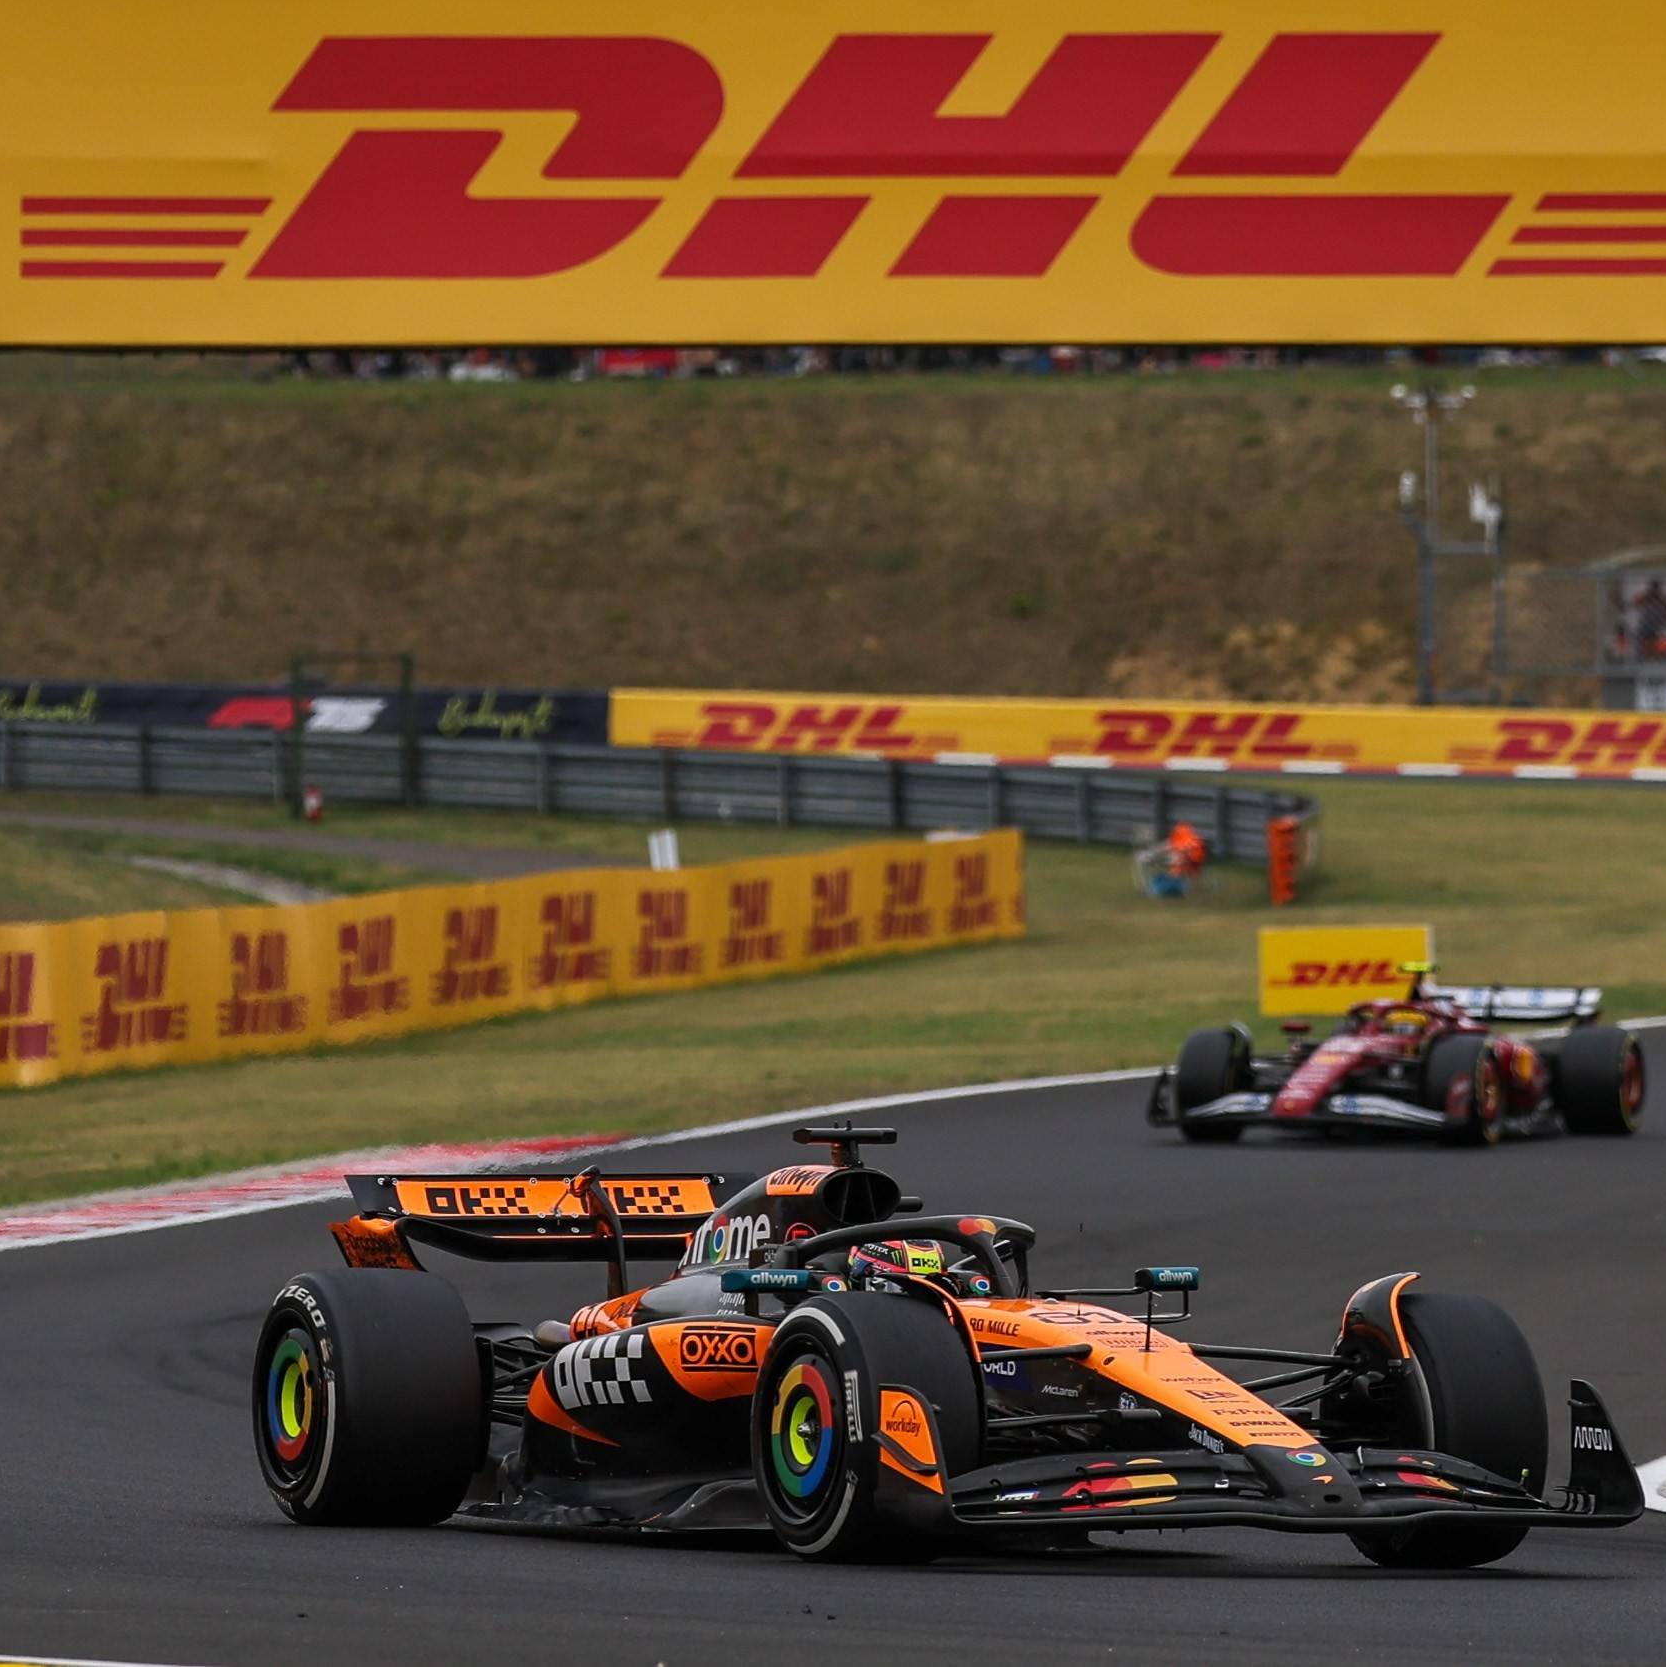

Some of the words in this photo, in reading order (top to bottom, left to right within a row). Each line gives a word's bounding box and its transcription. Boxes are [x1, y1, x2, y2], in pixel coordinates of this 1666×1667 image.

[245, 31, 1517, 278] DHL
[696, 704, 914, 749] DHL
[1093, 711, 1312, 757] DHL
[1287, 960, 1399, 987] DHL
[425, 1187, 529, 1214] OKX
[604, 1186, 686, 1214] KX
[750, 1272, 798, 1287] allwyn
[1158, 1270, 1193, 1283] allwyn
[284, 1284, 327, 1329] ZERO
[987, 1320, 1020, 1337] MILLE
[682, 1334, 754, 1365] OXXO
[554, 1334, 653, 1411] OKX
[983, 1360, 1016, 1377] ORLD
[1041, 1384, 1079, 1398] McLaren
[844, 1370, 863, 1443] PIRELLI
[885, 1420, 921, 1438] workday
